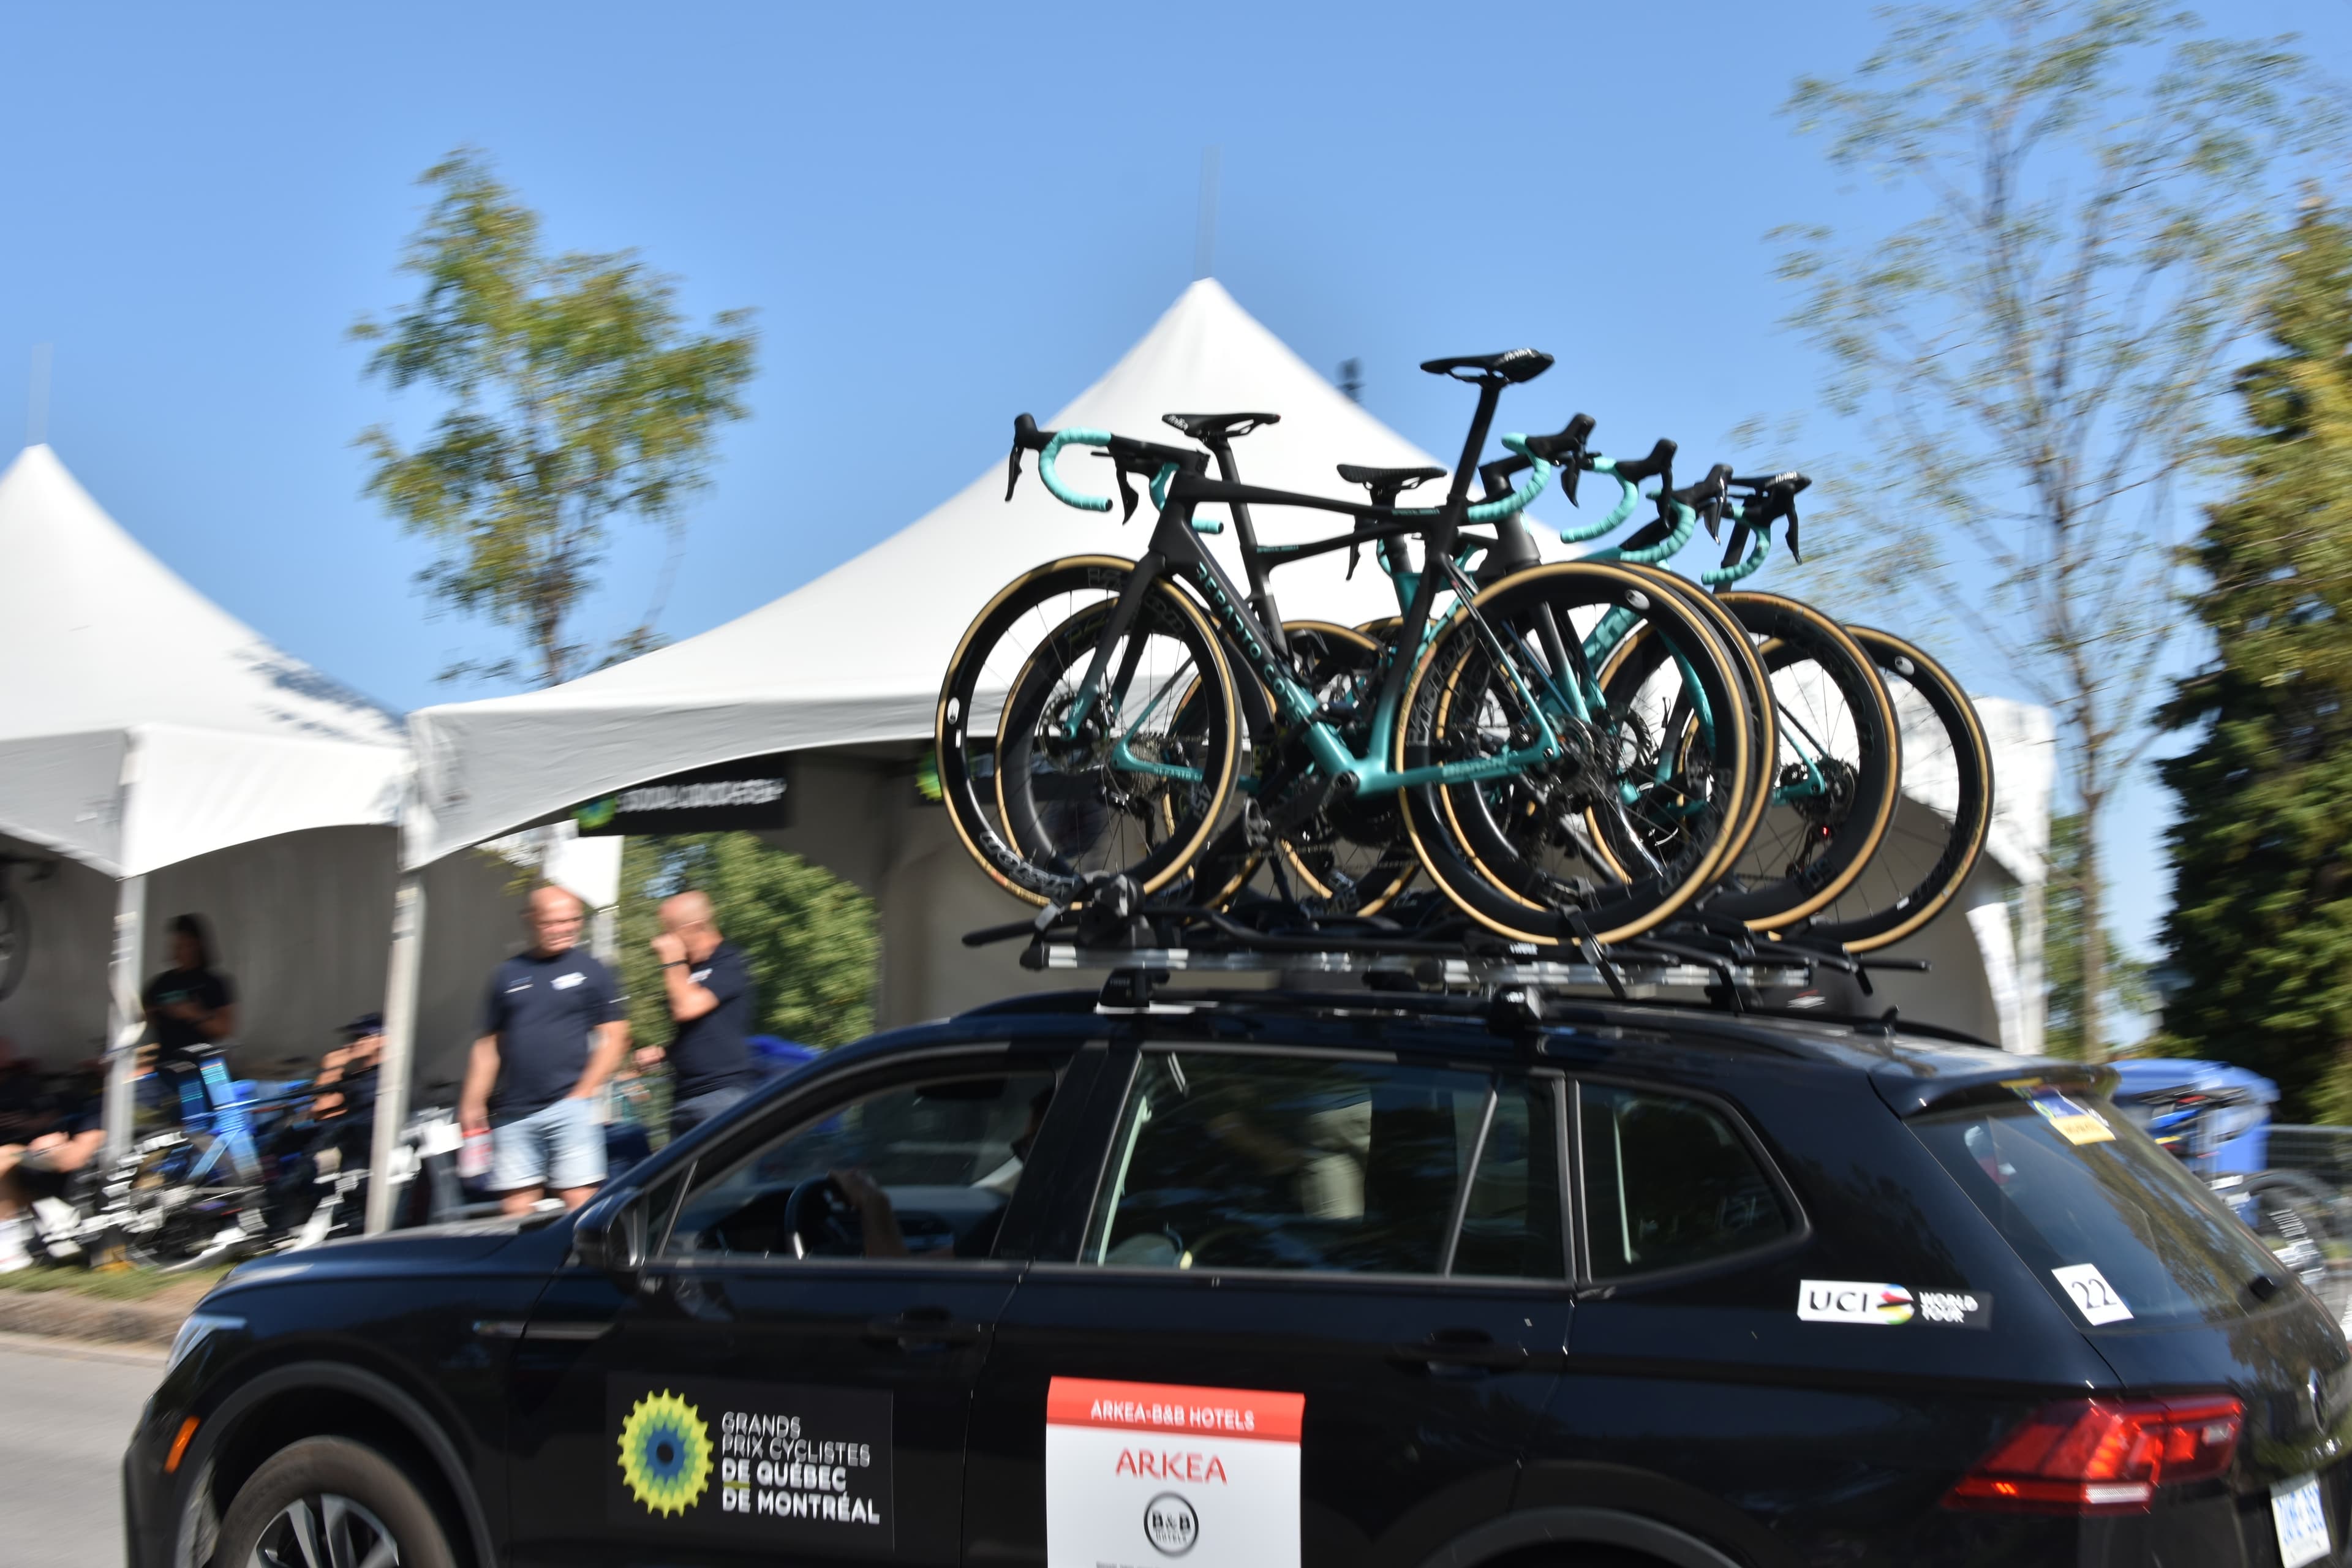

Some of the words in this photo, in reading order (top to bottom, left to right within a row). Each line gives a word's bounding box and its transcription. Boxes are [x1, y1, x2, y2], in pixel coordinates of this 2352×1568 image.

[1197, 561, 1262, 659] REPARTO
[1264, 664, 1305, 723] CORS
[1809, 1291, 1868, 1313] UCI
[1919, 1291, 1978, 1312] WORLD
[2071, 1278, 2118, 1310] 22
[722, 1411, 801, 1439] GRANDS
[1091, 1398, 1185, 1427] ARKEA-B&B
[1189, 1406, 1254, 1431] HOTELS
[722, 1433, 763, 1459] PRIX
[769, 1436, 870, 1468] CYCLISTES
[1116, 1447, 1227, 1485] ARKEA
[722, 1458, 750, 1483] DE
[756, 1458, 847, 1491] QUÉBEC
[722, 1487, 750, 1513] DE
[758, 1489, 880, 1524] MONTRÉAL
[1152, 1510, 1191, 1533] B&B
